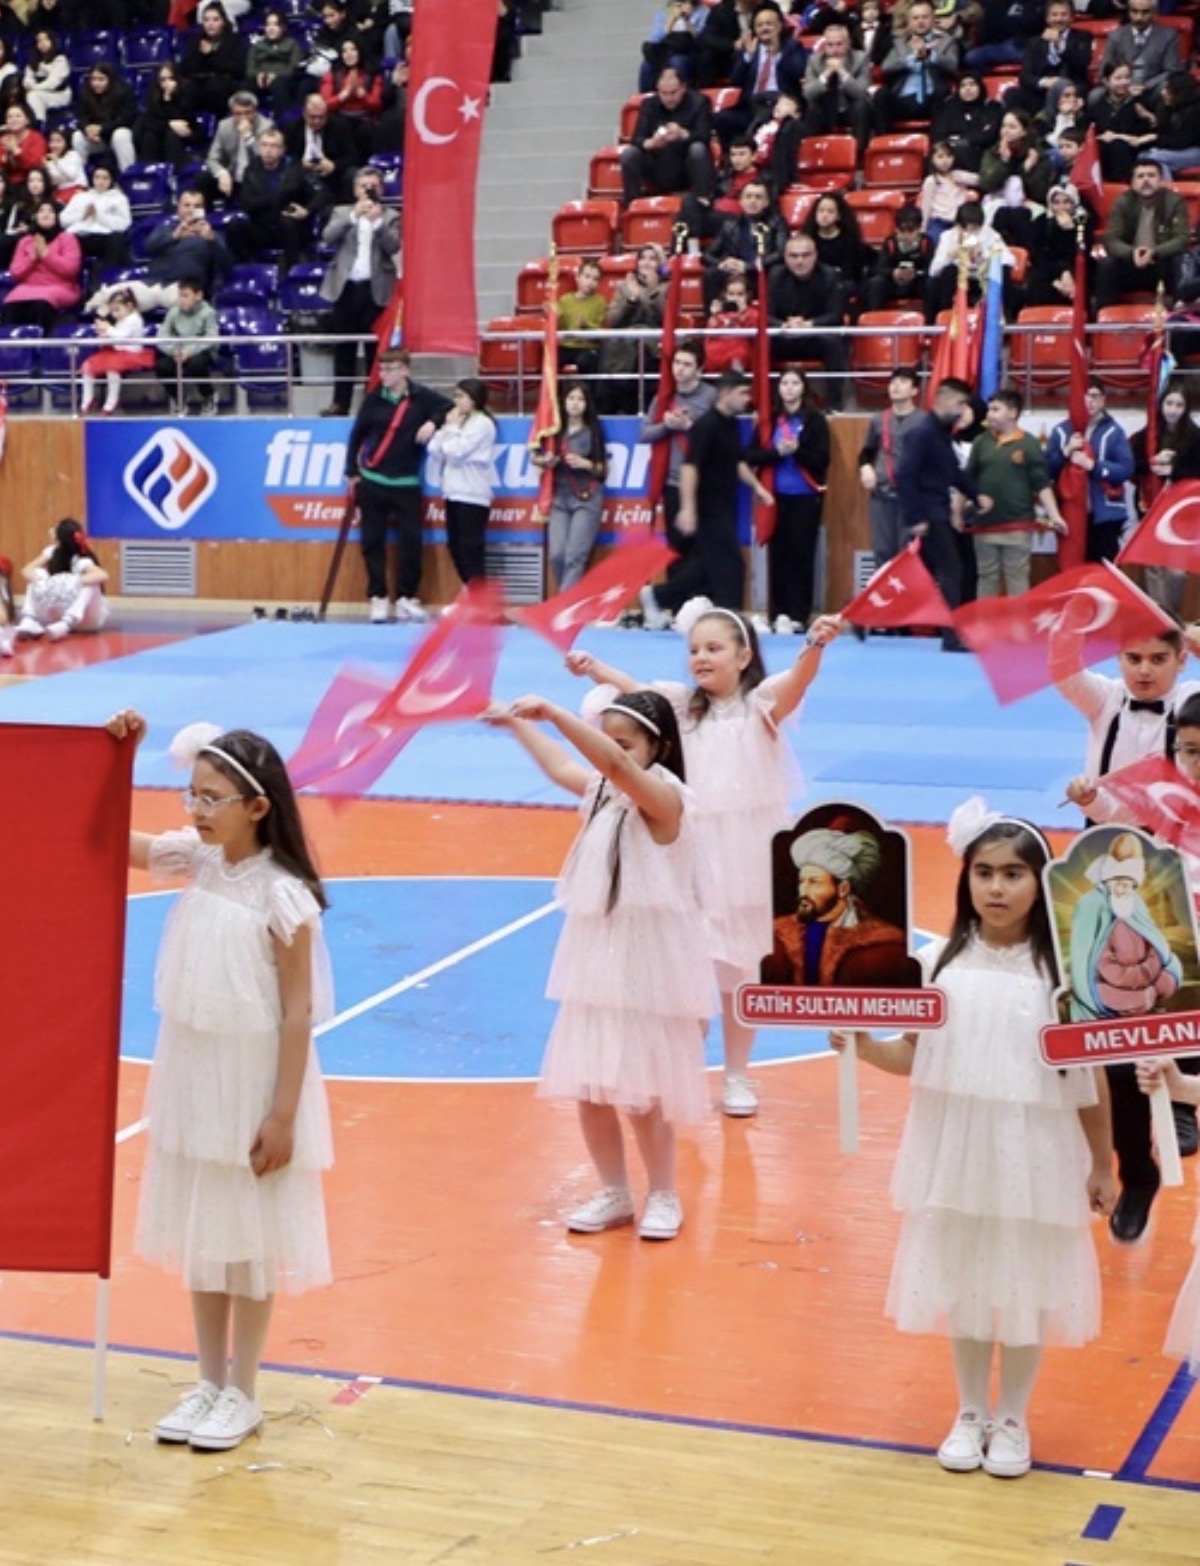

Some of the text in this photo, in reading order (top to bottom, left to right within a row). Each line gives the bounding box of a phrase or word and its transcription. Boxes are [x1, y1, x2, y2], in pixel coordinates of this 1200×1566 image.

[264, 429, 347, 486] fin
[746, 991, 937, 1018] FATİH SULTAN MEHMET
[1083, 1020, 1200, 1052] MEVLAN
